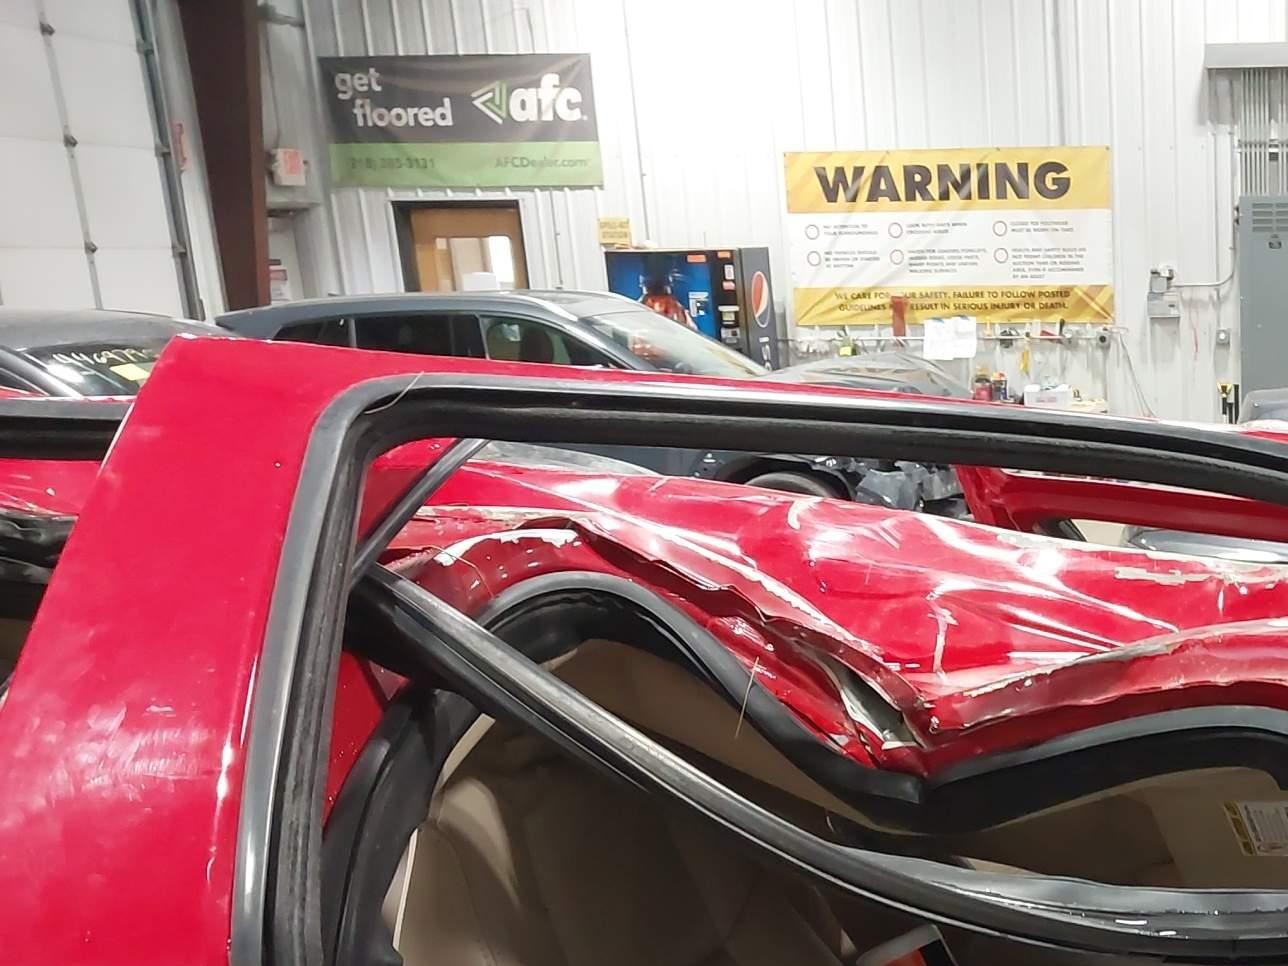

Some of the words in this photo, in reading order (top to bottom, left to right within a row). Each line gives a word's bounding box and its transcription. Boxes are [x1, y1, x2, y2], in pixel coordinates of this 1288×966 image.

[335, 67, 382, 100] get
[353, 98, 453, 127] floored
[815, 161, 1071, 203] WARNING
[850, 291, 871, 300] CARE
[953, 290, 985, 299] FAILURE
[988, 290, 999, 298] TO
[1001, 290, 1036, 298] FOLLOW
[1038, 290, 1071, 298] POSTED
[940, 302, 950, 310] IN
[953, 302, 988, 310] SERIOUS
[990, 302, 1020, 310] INJURY
[1023, 301, 1036, 310] OR
